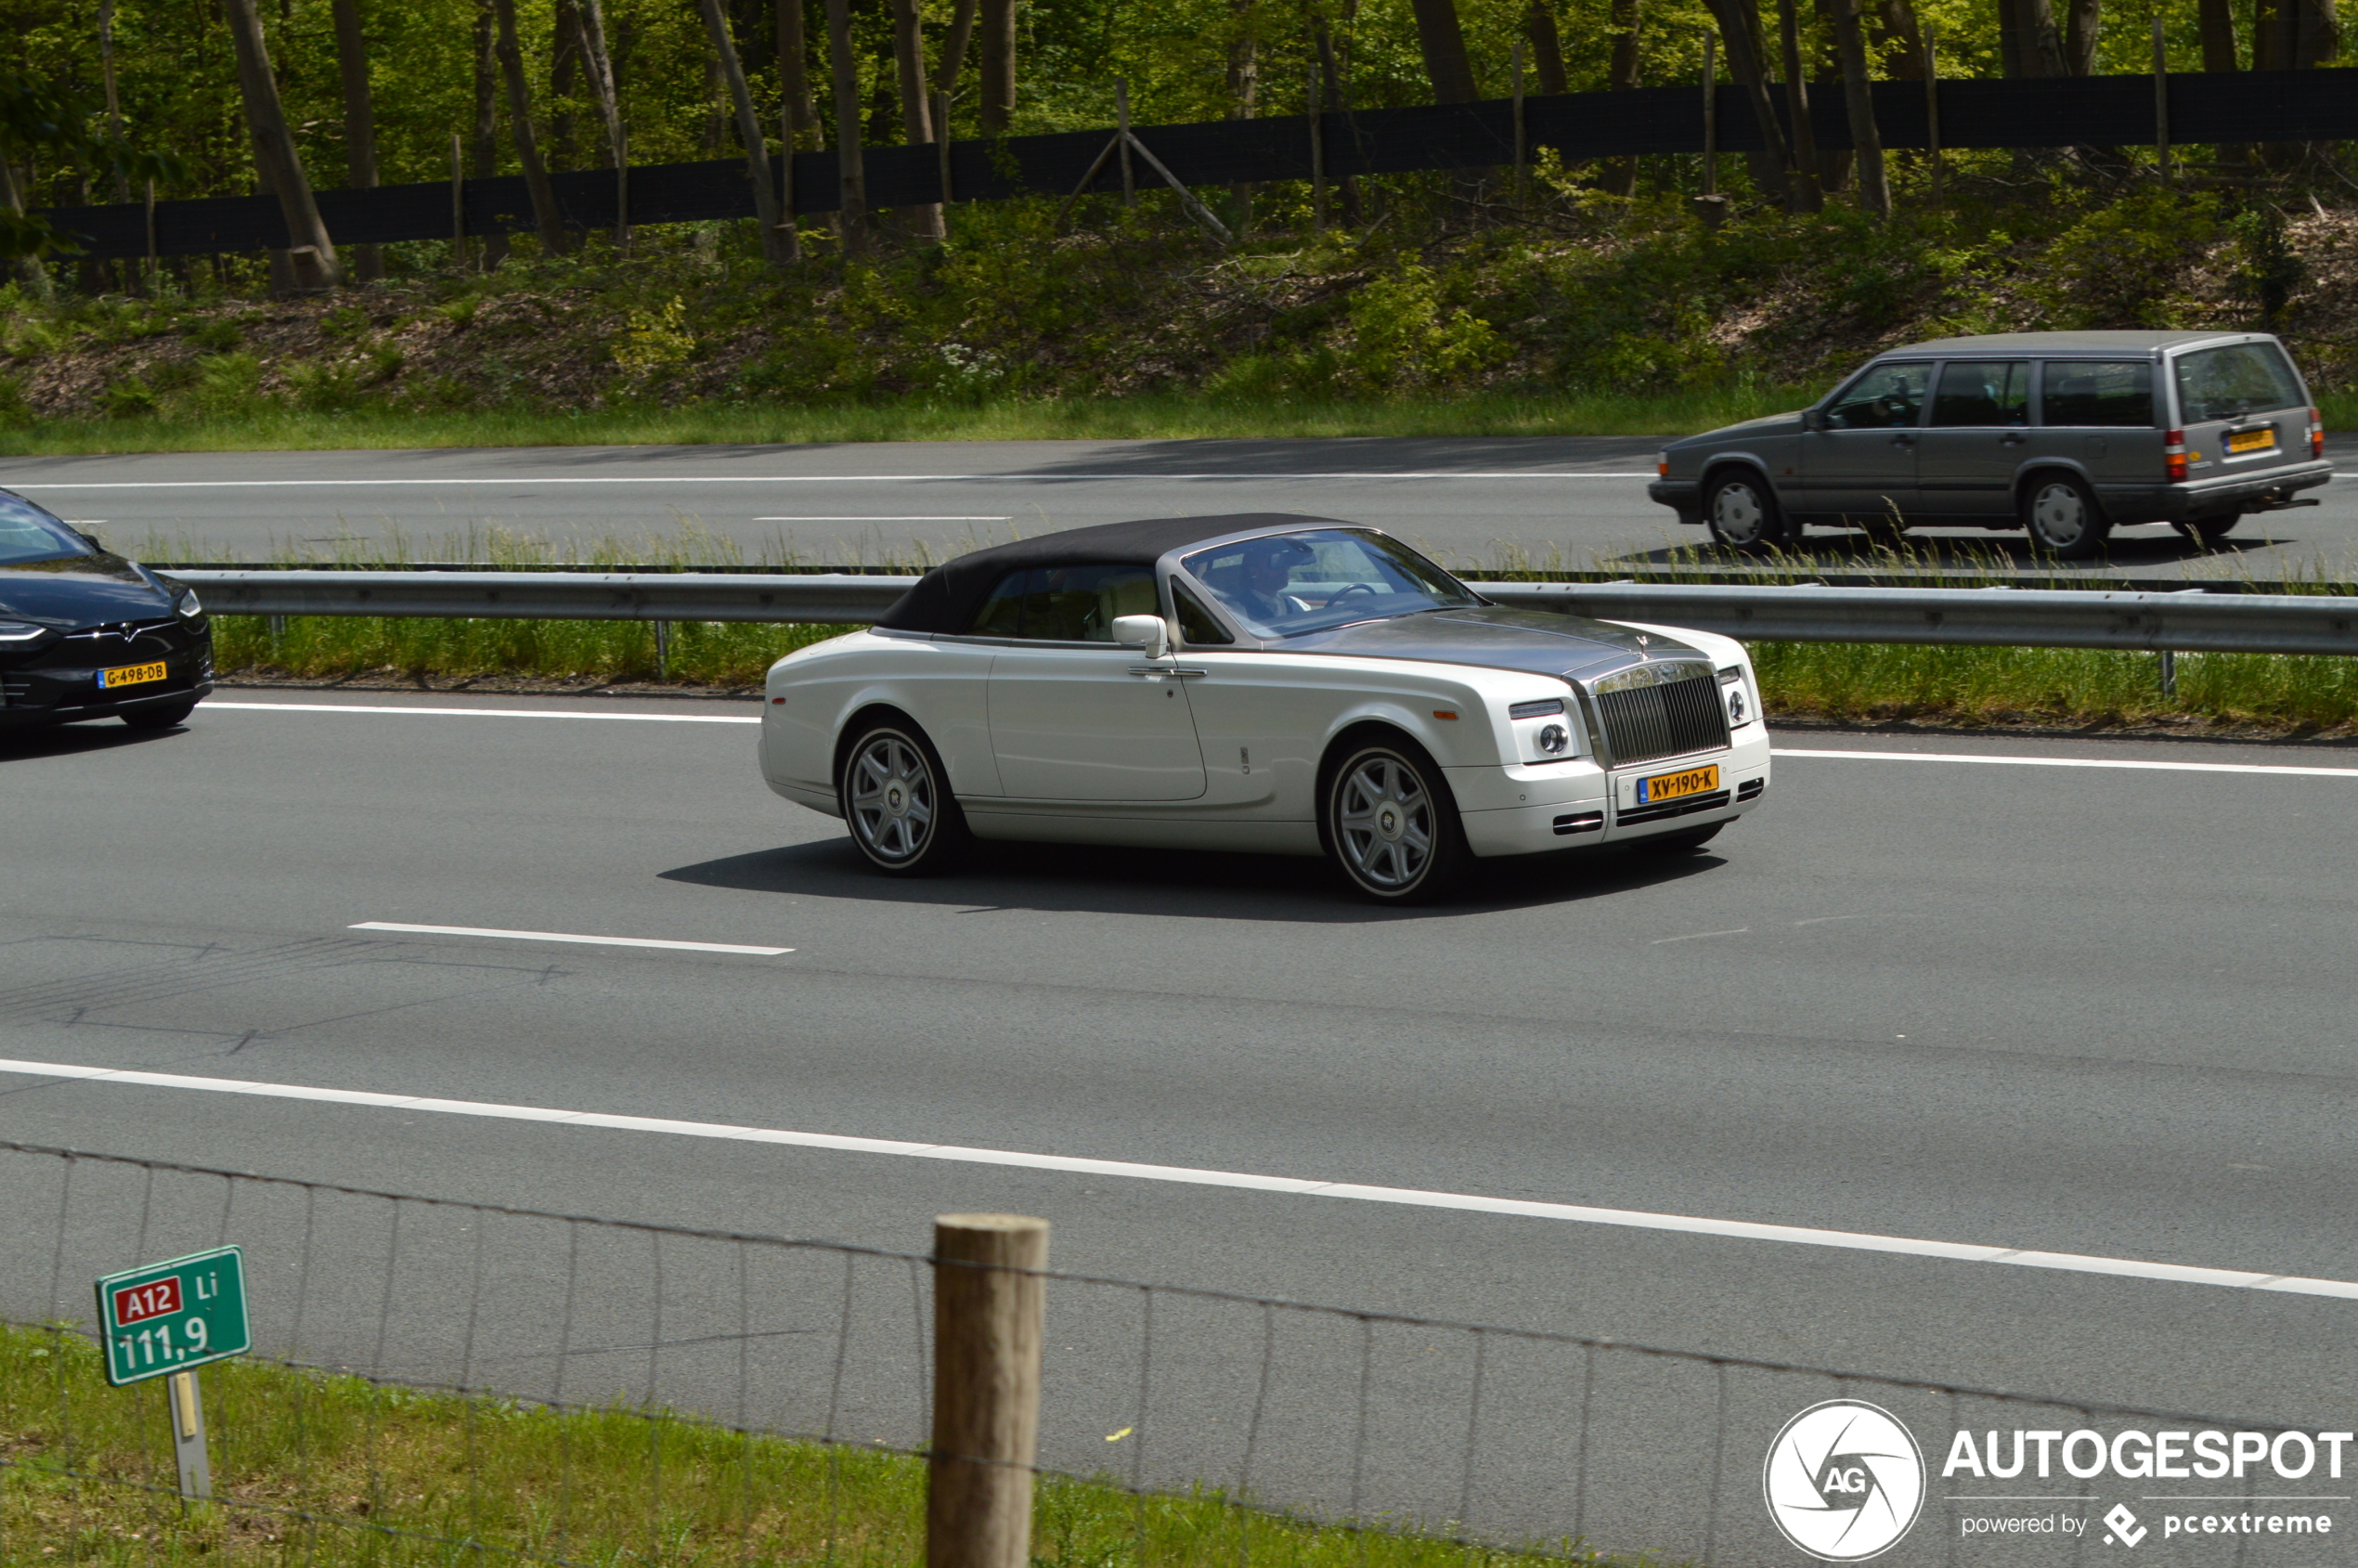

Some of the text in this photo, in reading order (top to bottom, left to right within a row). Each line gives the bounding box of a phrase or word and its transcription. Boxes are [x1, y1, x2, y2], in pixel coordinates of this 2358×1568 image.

[108, 665, 163, 684] G-498-DB
[1652, 770, 1712, 799] XV-190-K
[126, 1271, 218, 1318] A12 Li
[118, 1316, 208, 1369] 111,9
